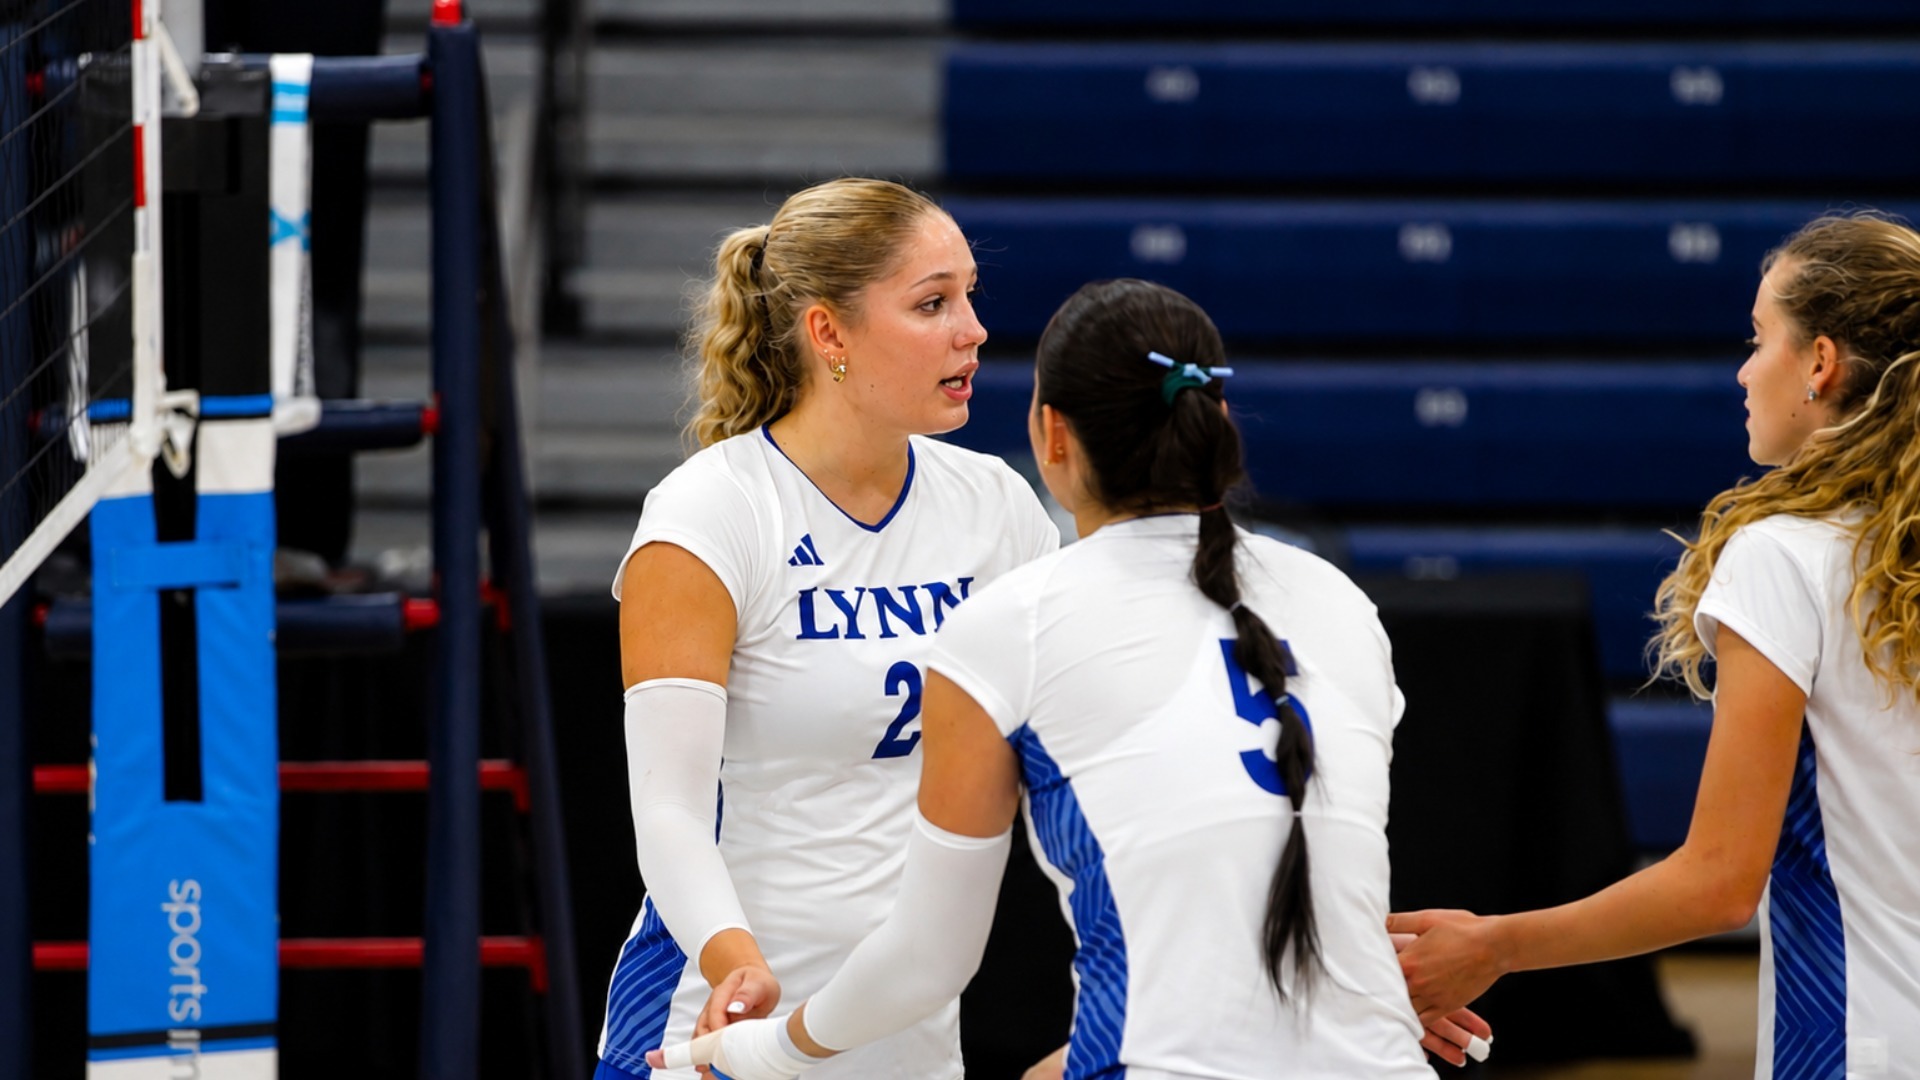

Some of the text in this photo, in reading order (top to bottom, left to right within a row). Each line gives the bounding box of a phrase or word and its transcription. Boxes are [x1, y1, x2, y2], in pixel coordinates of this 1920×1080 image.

[871, 660, 923, 760] 2
[1218, 638, 1316, 797] 5
[161, 878, 208, 1022] sports
